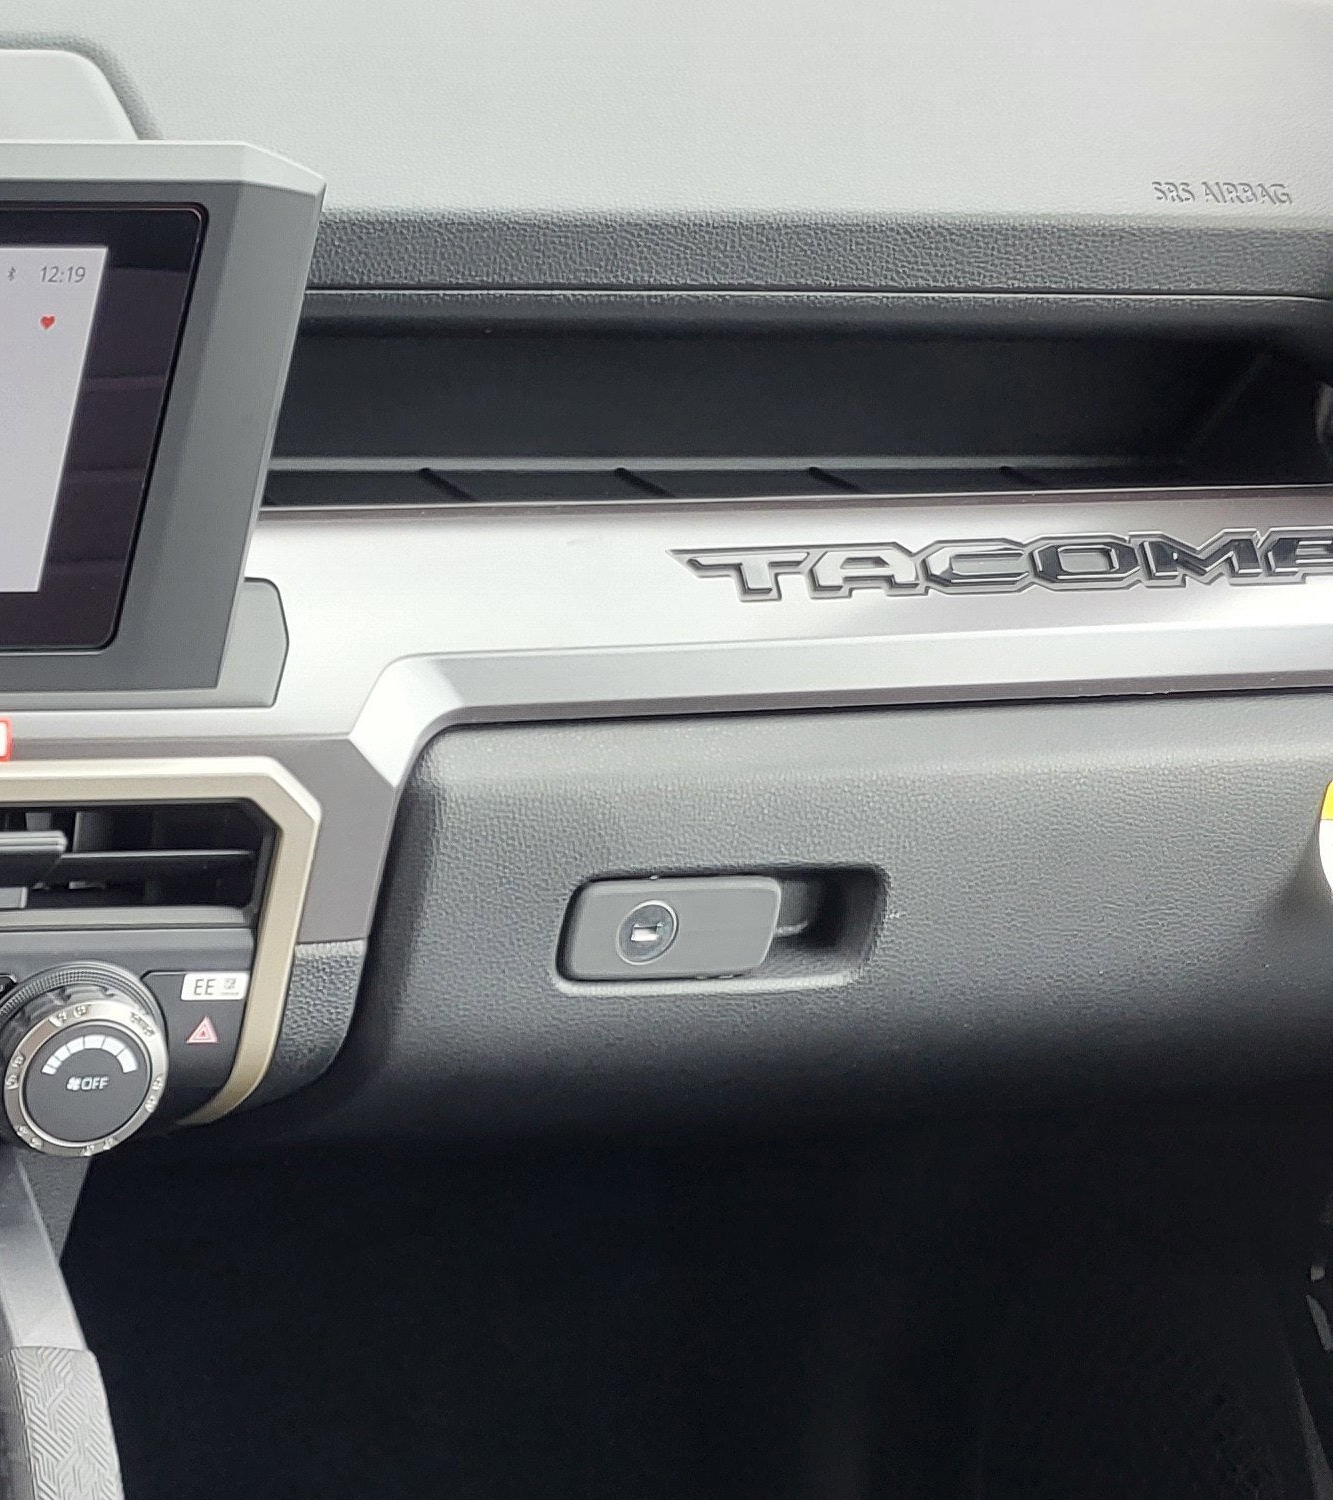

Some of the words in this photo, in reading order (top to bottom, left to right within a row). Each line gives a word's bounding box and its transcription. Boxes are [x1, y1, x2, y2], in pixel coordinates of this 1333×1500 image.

[1152, 181, 1196, 202] SRS
[1201, 181, 1293, 204] AIRBAG
[40, 265, 86, 283] 12:19
[194, 978, 216, 996] EE
[81, 1076, 109, 1090] OFF
